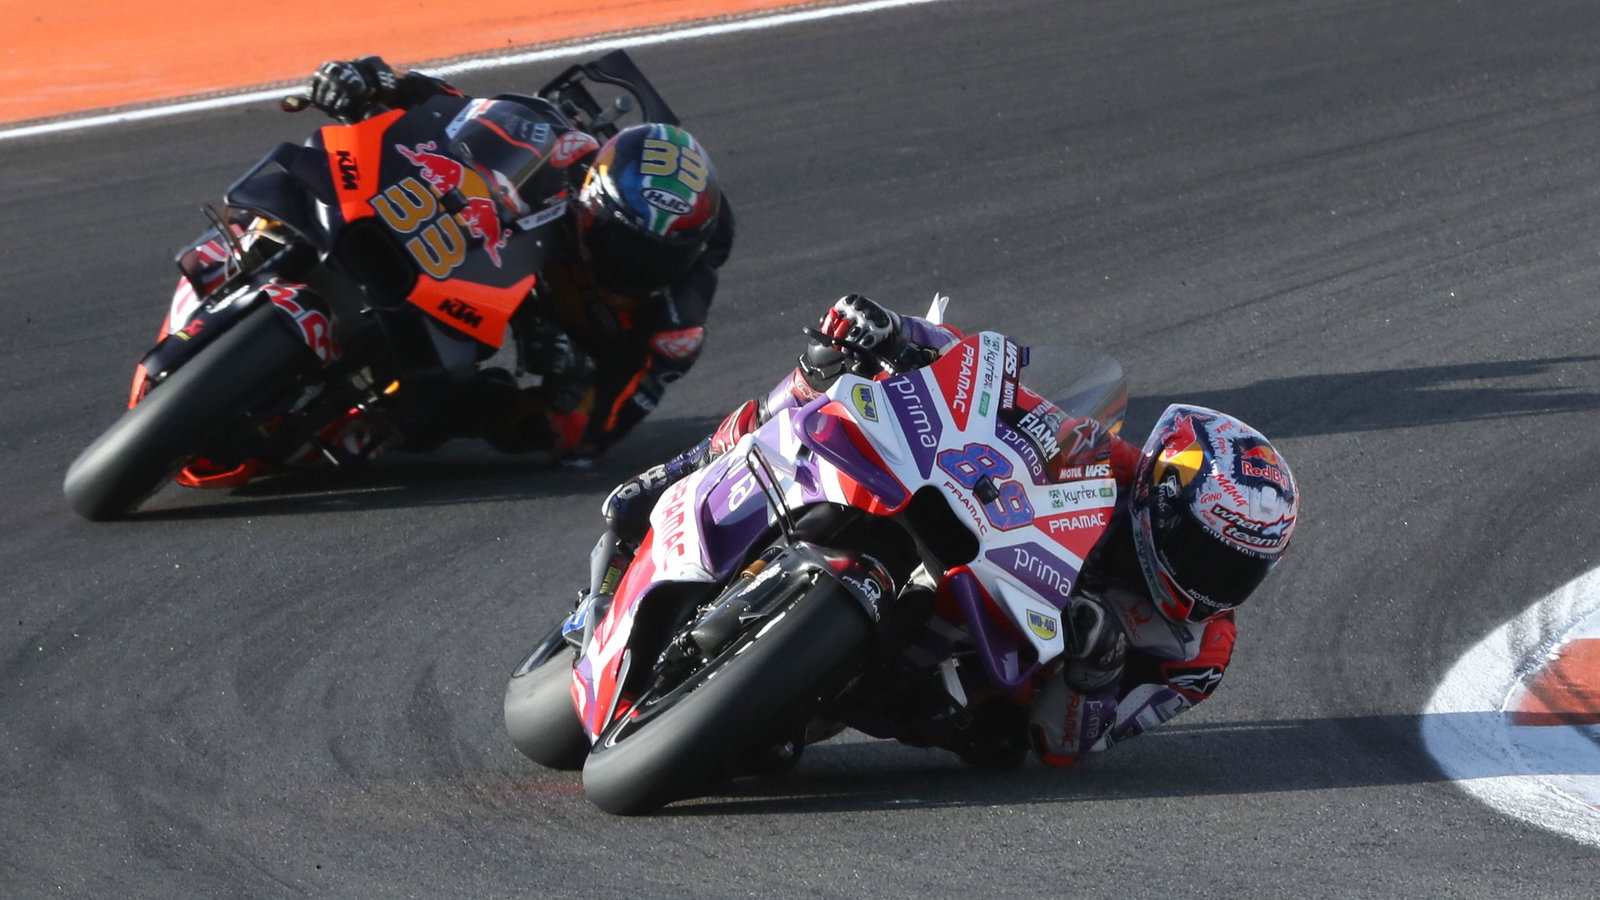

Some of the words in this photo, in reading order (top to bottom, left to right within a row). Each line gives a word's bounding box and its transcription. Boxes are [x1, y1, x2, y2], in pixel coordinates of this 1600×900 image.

[336, 150, 359, 191] KTM
[640, 139, 709, 193] 33
[649, 190, 688, 212] HJC
[369, 176, 467, 279] 33
[437, 298, 484, 329] KTM
[952, 343, 975, 414] PRAMAC
[984, 349, 999, 388] kyrrex
[889, 376, 938, 448] prima
[1002, 380, 1015, 409] MOTUL
[1002, 429, 1043, 477] prima
[1241, 460, 1271, 480] Red
[936, 442, 1036, 533] 89
[1059, 465, 1083, 479] MOTUL
[1213, 473, 1249, 507] MAMA
[943, 481, 988, 536] PRAMAC
[1063, 486, 1098, 505] kyrrex
[1048, 512, 1107, 534] PRAMAC
[1213, 504, 1262, 532] what
[1014, 548, 1072, 598] prima
[1029, 612, 1055, 633] WD-40
